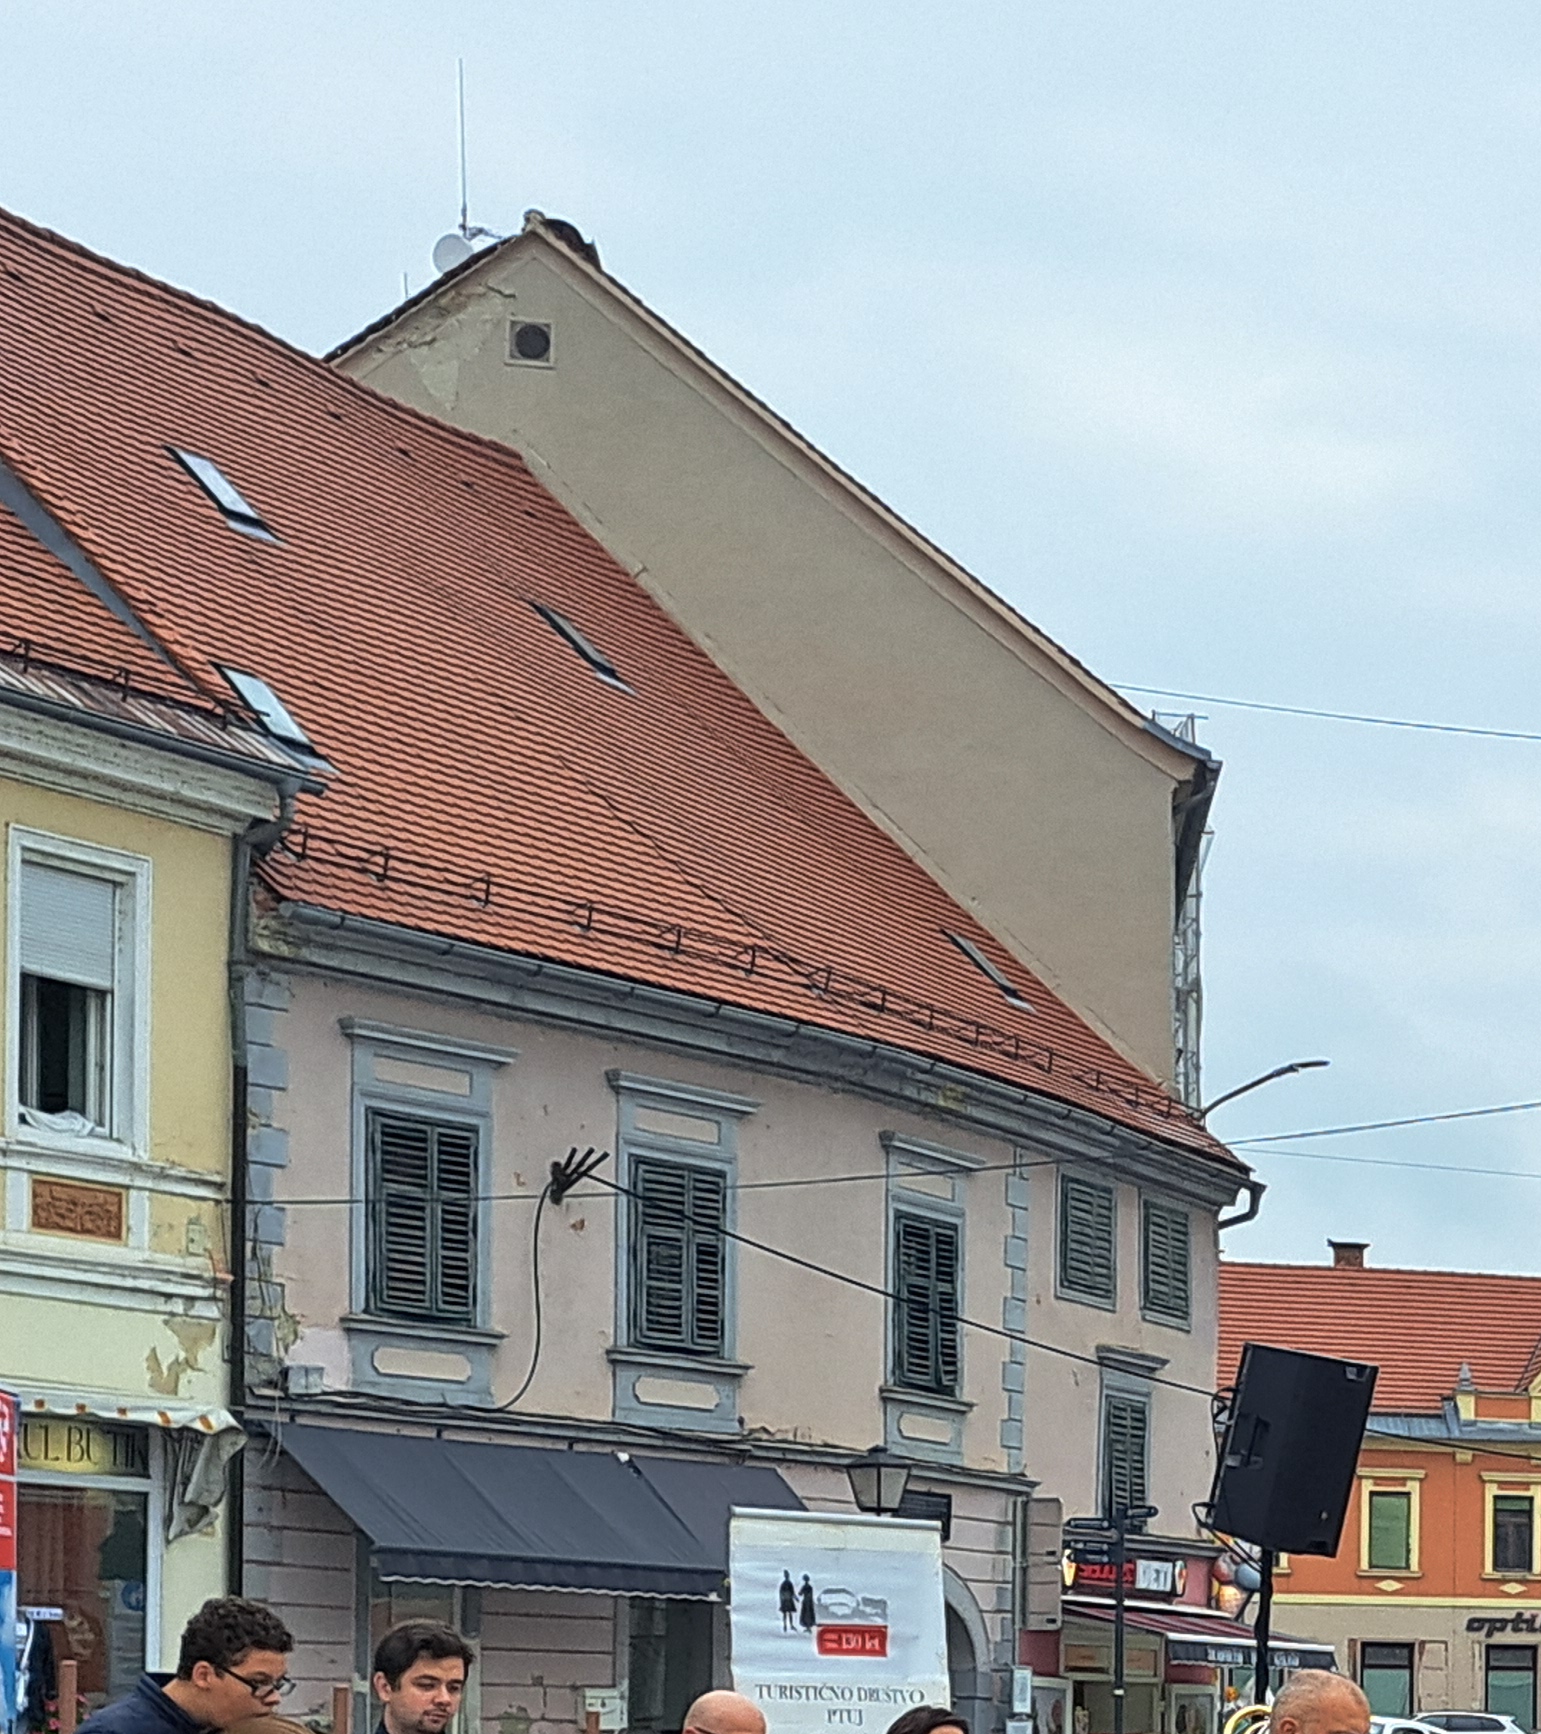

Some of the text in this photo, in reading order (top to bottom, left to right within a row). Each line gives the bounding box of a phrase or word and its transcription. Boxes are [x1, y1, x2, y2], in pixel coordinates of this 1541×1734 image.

[841, 1632, 880, 1651] 130 let
[755, 1683, 926, 1704] TURISTIČNO DRUŠTVO
[827, 1708, 864, 1726] PTUJ
